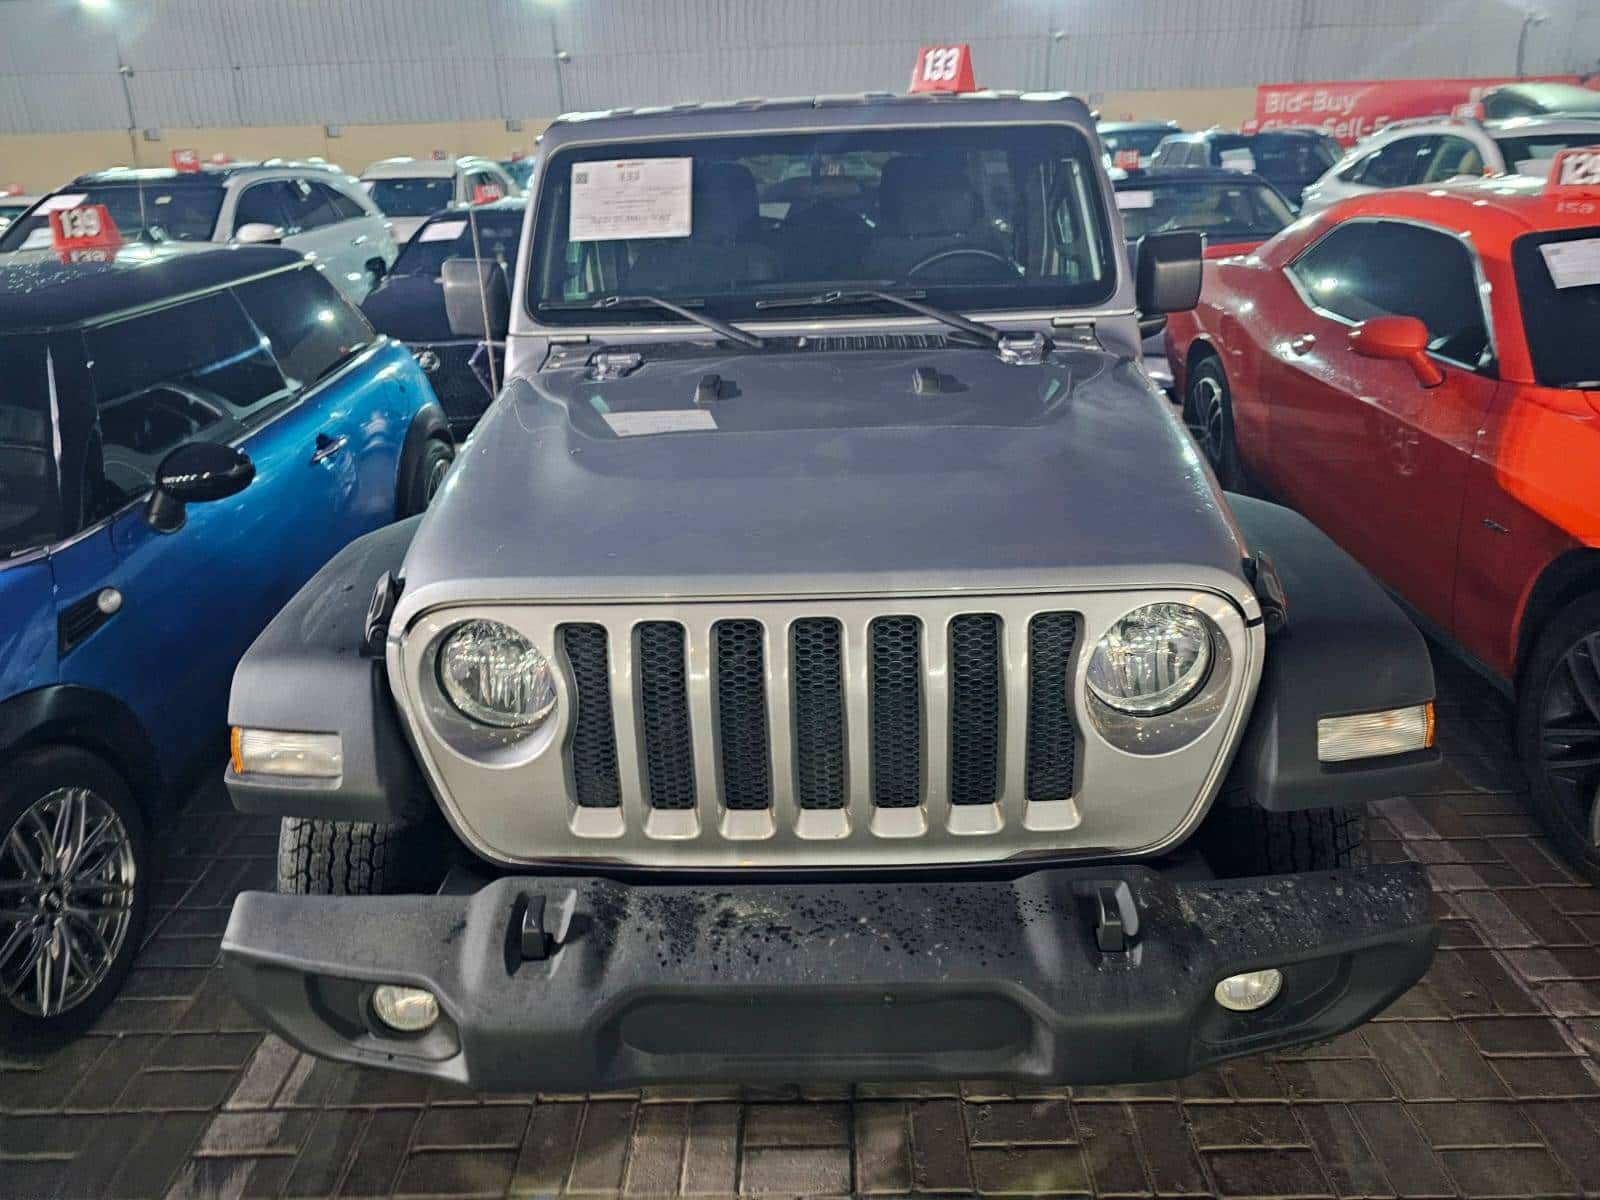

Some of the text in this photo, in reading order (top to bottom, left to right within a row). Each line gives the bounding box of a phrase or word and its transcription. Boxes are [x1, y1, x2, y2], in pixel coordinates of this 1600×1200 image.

[923, 47, 960, 80] 133
[1265, 90, 1355, 115] Bid-Buy
[60, 207, 101, 238] 139
